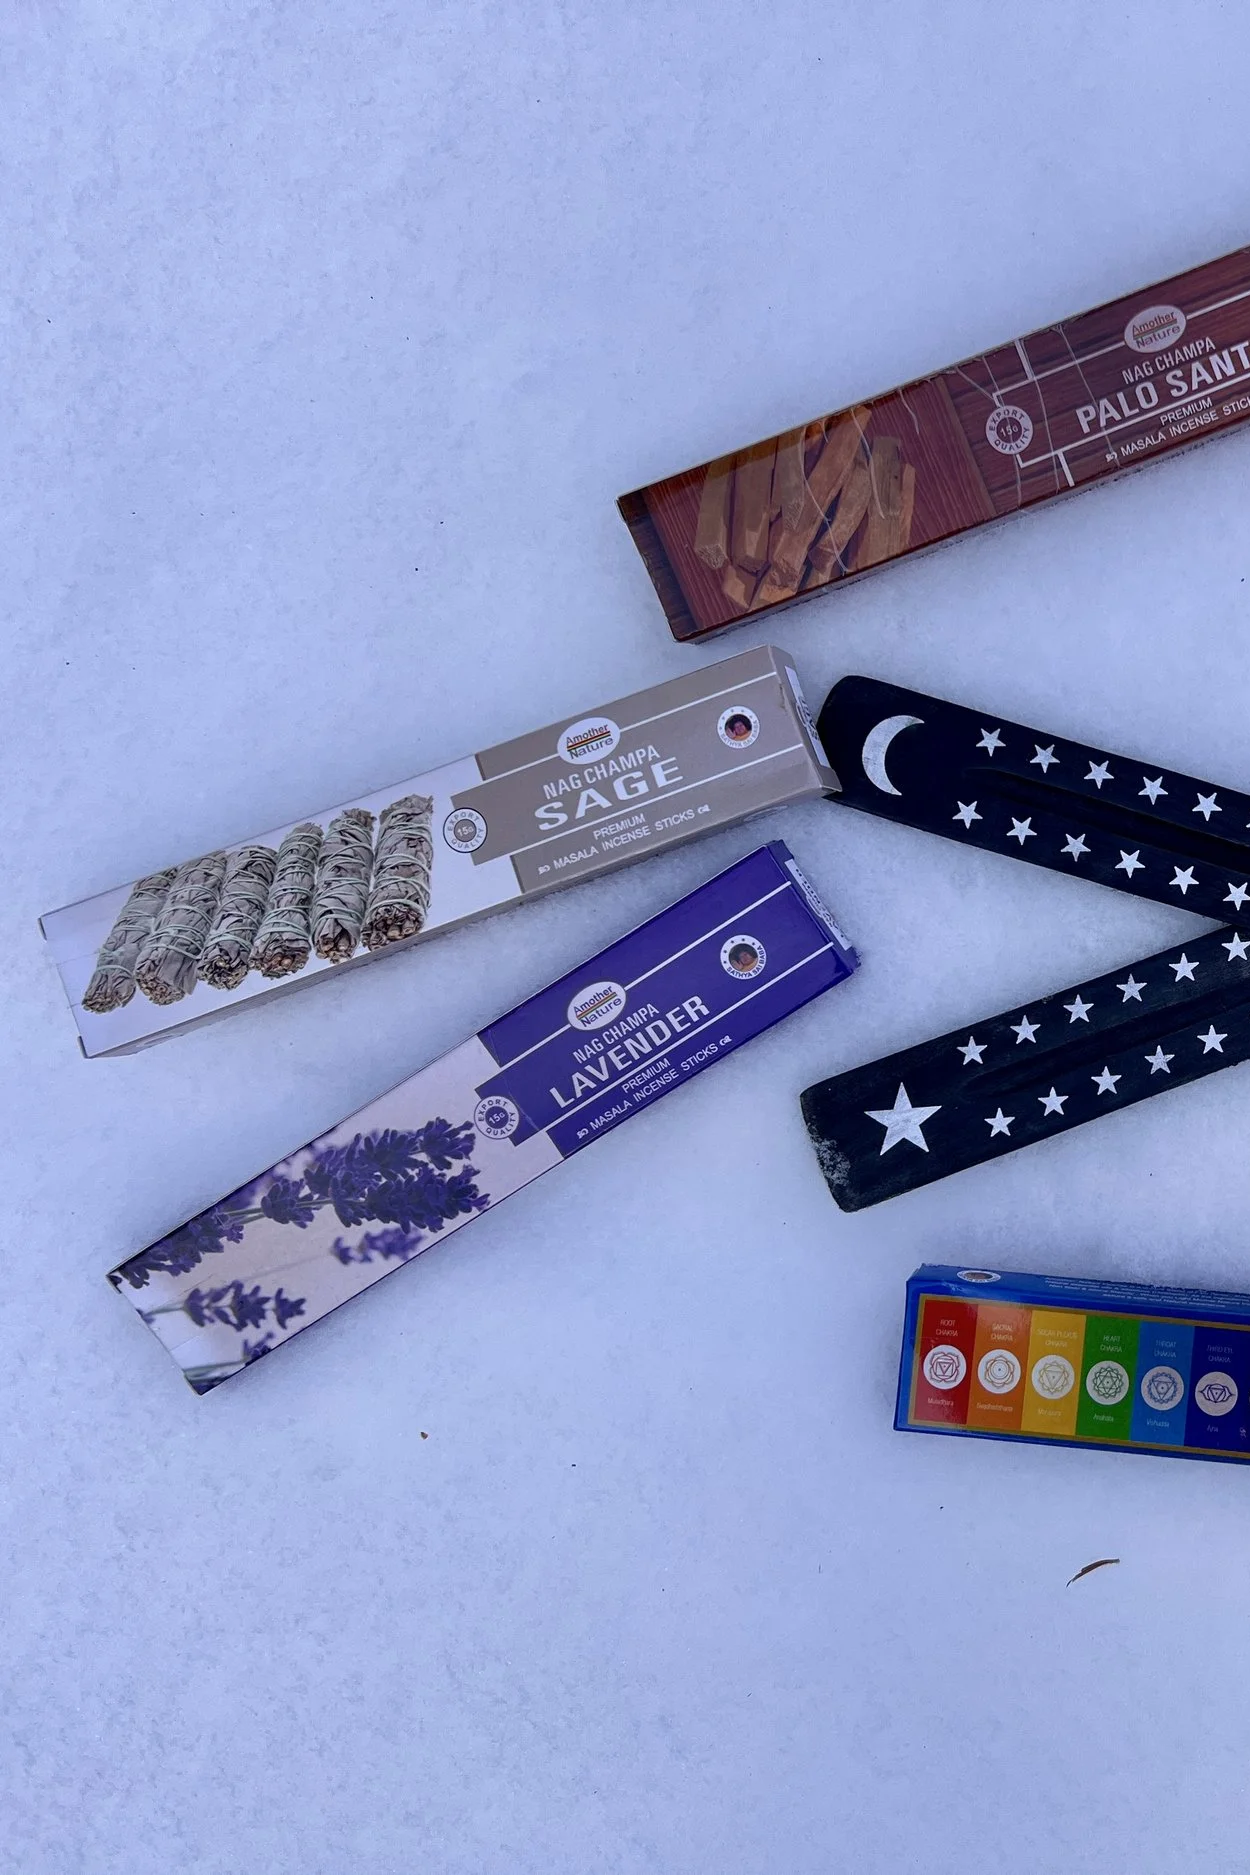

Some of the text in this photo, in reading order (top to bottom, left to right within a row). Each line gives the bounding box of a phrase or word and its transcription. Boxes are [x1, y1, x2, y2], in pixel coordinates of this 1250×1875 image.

[1132, 312, 1175, 335] Amother
[1137, 326, 1180, 348] Nature
[1122, 336, 1216, 384] NAG CHAMPA
[989, 409, 1024, 431] EXPORT
[1076, 382, 1159, 433] PALO
[1160, 397, 1213, 426] PREMIUM
[995, 427, 1030, 451] QUALITY
[1121, 431, 1166, 457] MASALA
[1169, 412, 1218, 437] INCENSE
[566, 724, 608, 746] Amother
[570, 737, 613, 760] Nature
[543, 745, 660, 800] NAG CHAMPA
[534, 757, 683, 831] SAGE
[448, 812, 479, 831] EXPORT
[593, 813, 645, 840] PREMIUM
[452, 828, 484, 848] QUALITY
[553, 810, 695, 869] MASALA INCENSE STICKS
[573, 985, 614, 1014] Amother
[581, 998, 622, 1027] Nature
[573, 1003, 659, 1064] NAG CHAMPA
[550, 995, 710, 1109] LAVENDER
[590, 1043, 718, 1131] MASALA INCENSE STICKS
[622, 1058, 670, 1093] PREMIUM
[478, 1099, 507, 1121] EXPORT
[486, 1112, 516, 1136] QUALITY
